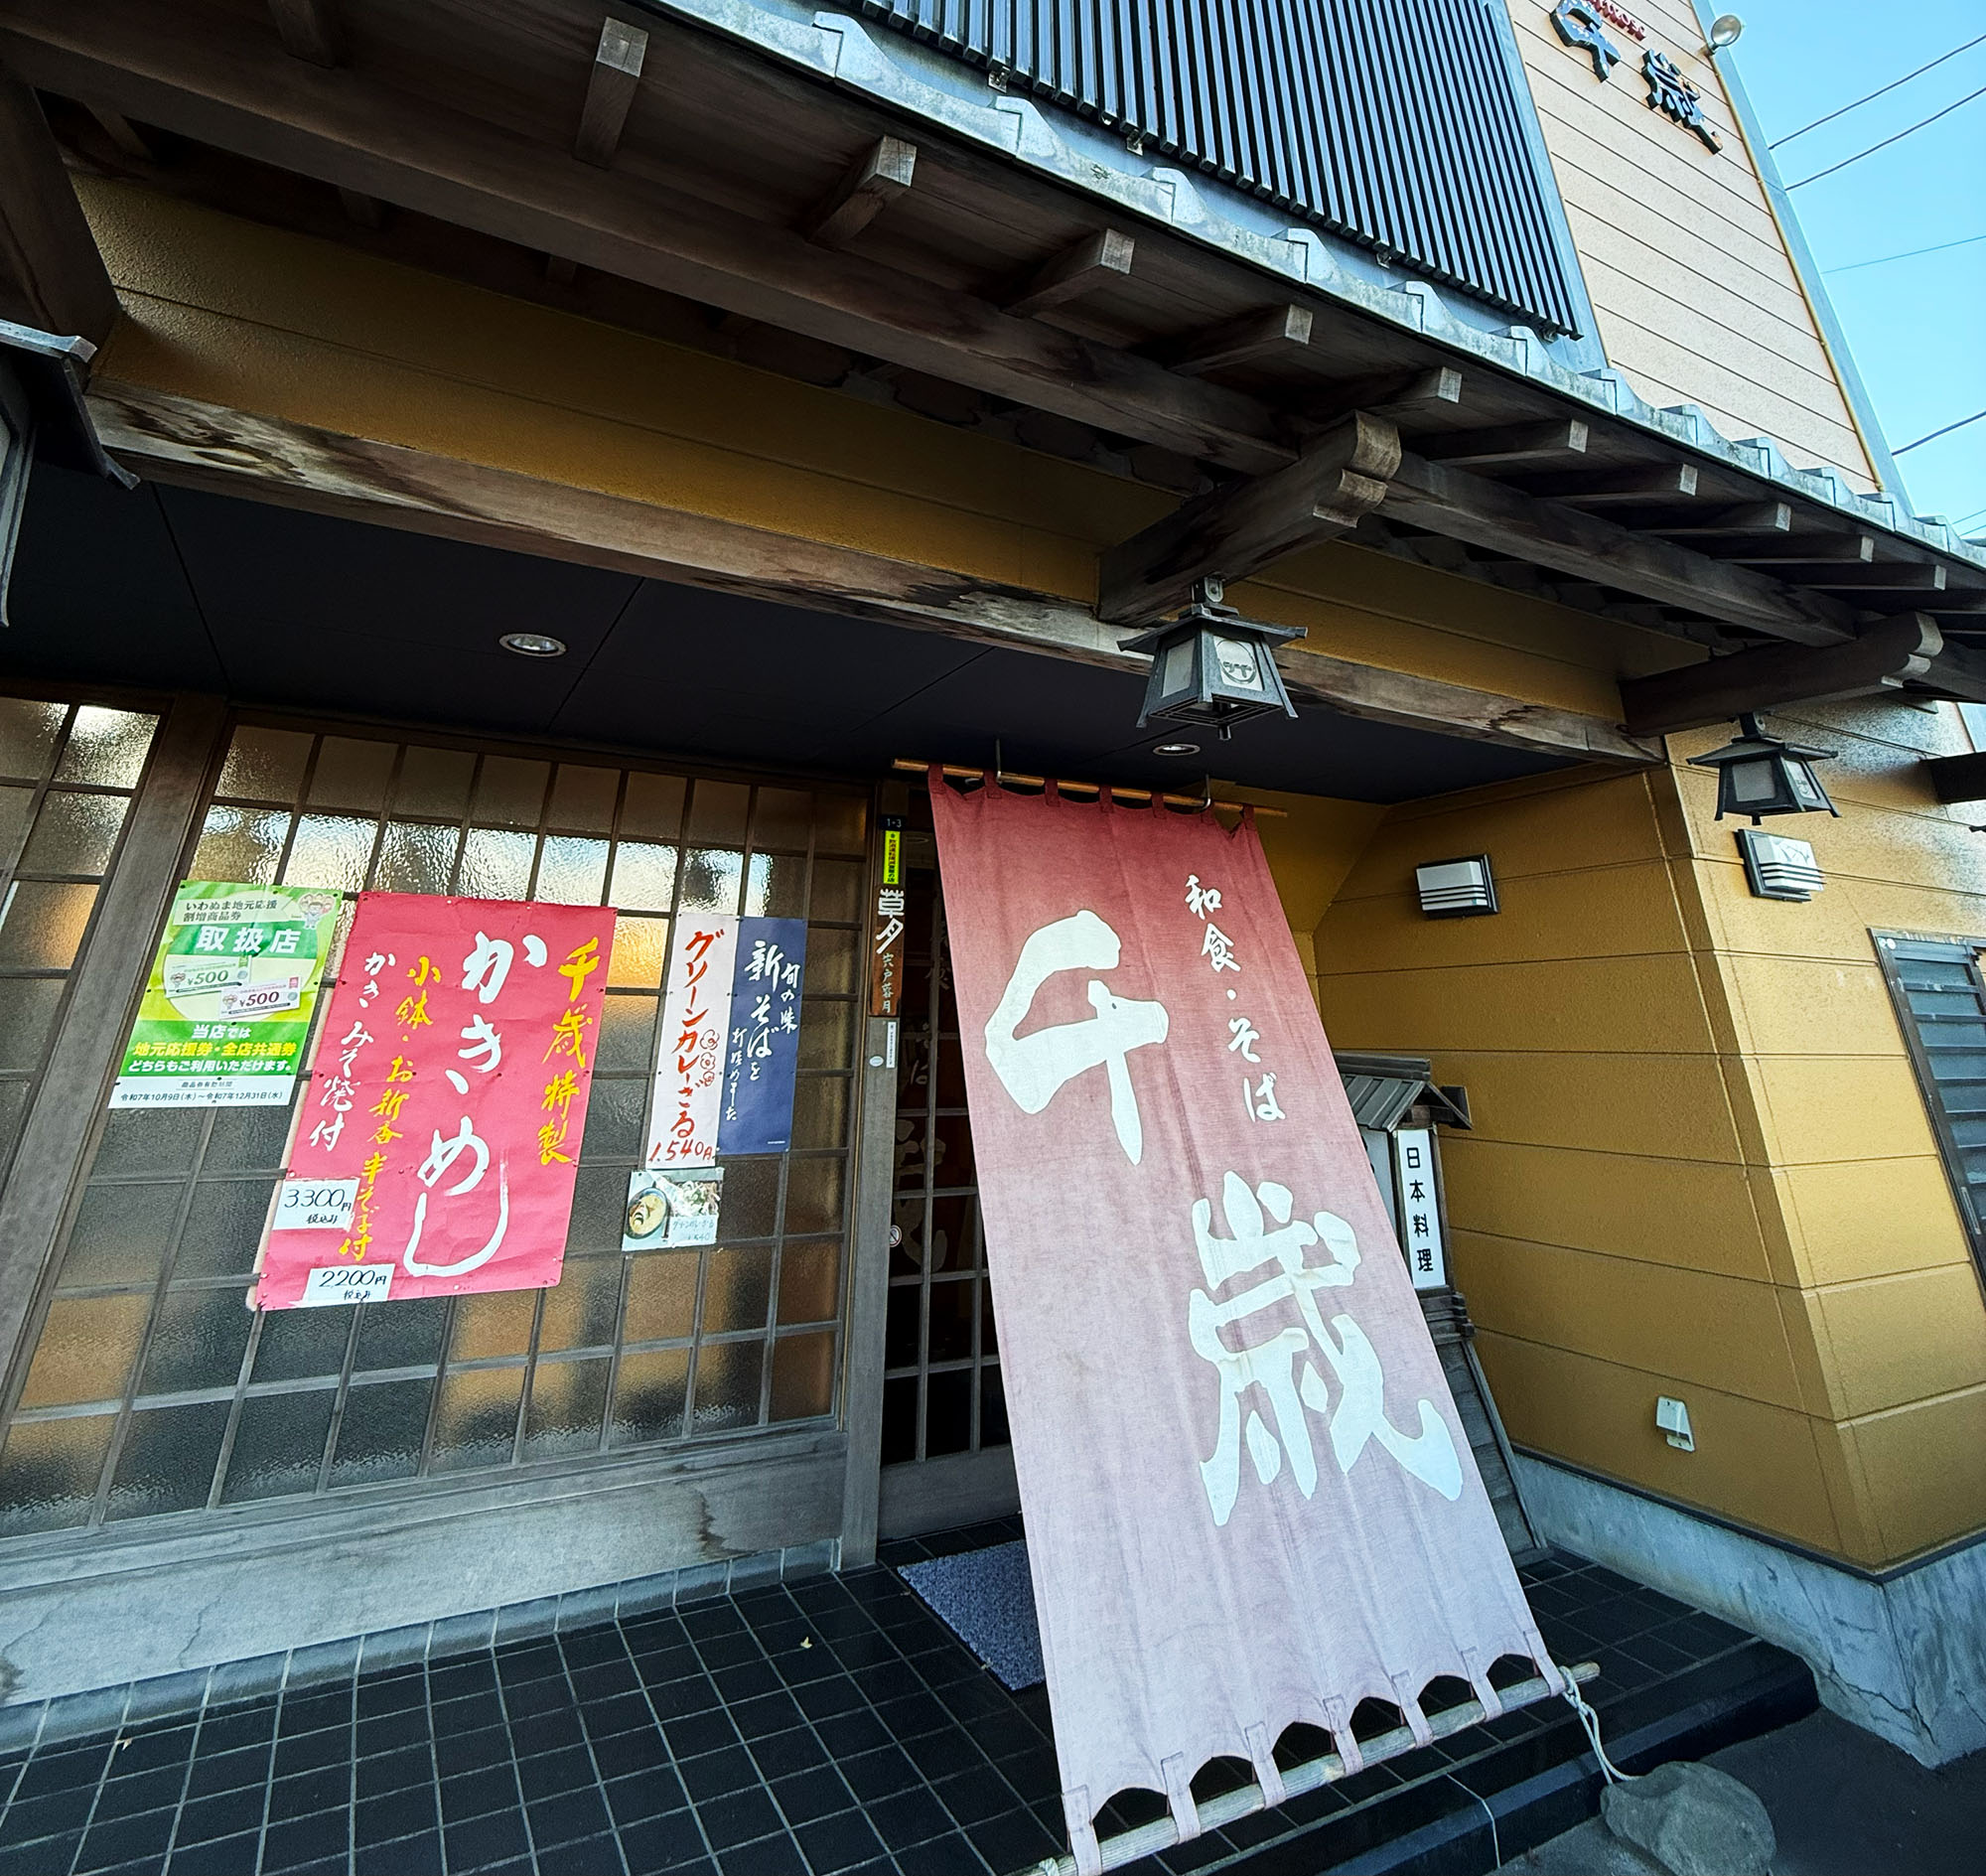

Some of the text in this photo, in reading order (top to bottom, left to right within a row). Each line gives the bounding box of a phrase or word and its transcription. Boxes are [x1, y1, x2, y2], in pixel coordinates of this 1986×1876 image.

[183, 911, 241, 922] 割増商品券
[186, 899, 278, 911] いわぬま地元応援
[196, 925, 301, 954] 取扱店
[780, 962, 801, 1034] 旬の味
[1185, 874, 1286, 1123] 和食・そば
[192, 1024, 251, 1040] 当店では
[132, 1043, 297, 1057] 地元応援券・全店共通券
[537, 937, 599, 1166] 千歳特製
[128, 1059, 292, 1073] どちらもご利用いただけます。
[985, 910, 1462, 1526] 千歳
[1406, 1146, 1434, 1273] 日本料理
